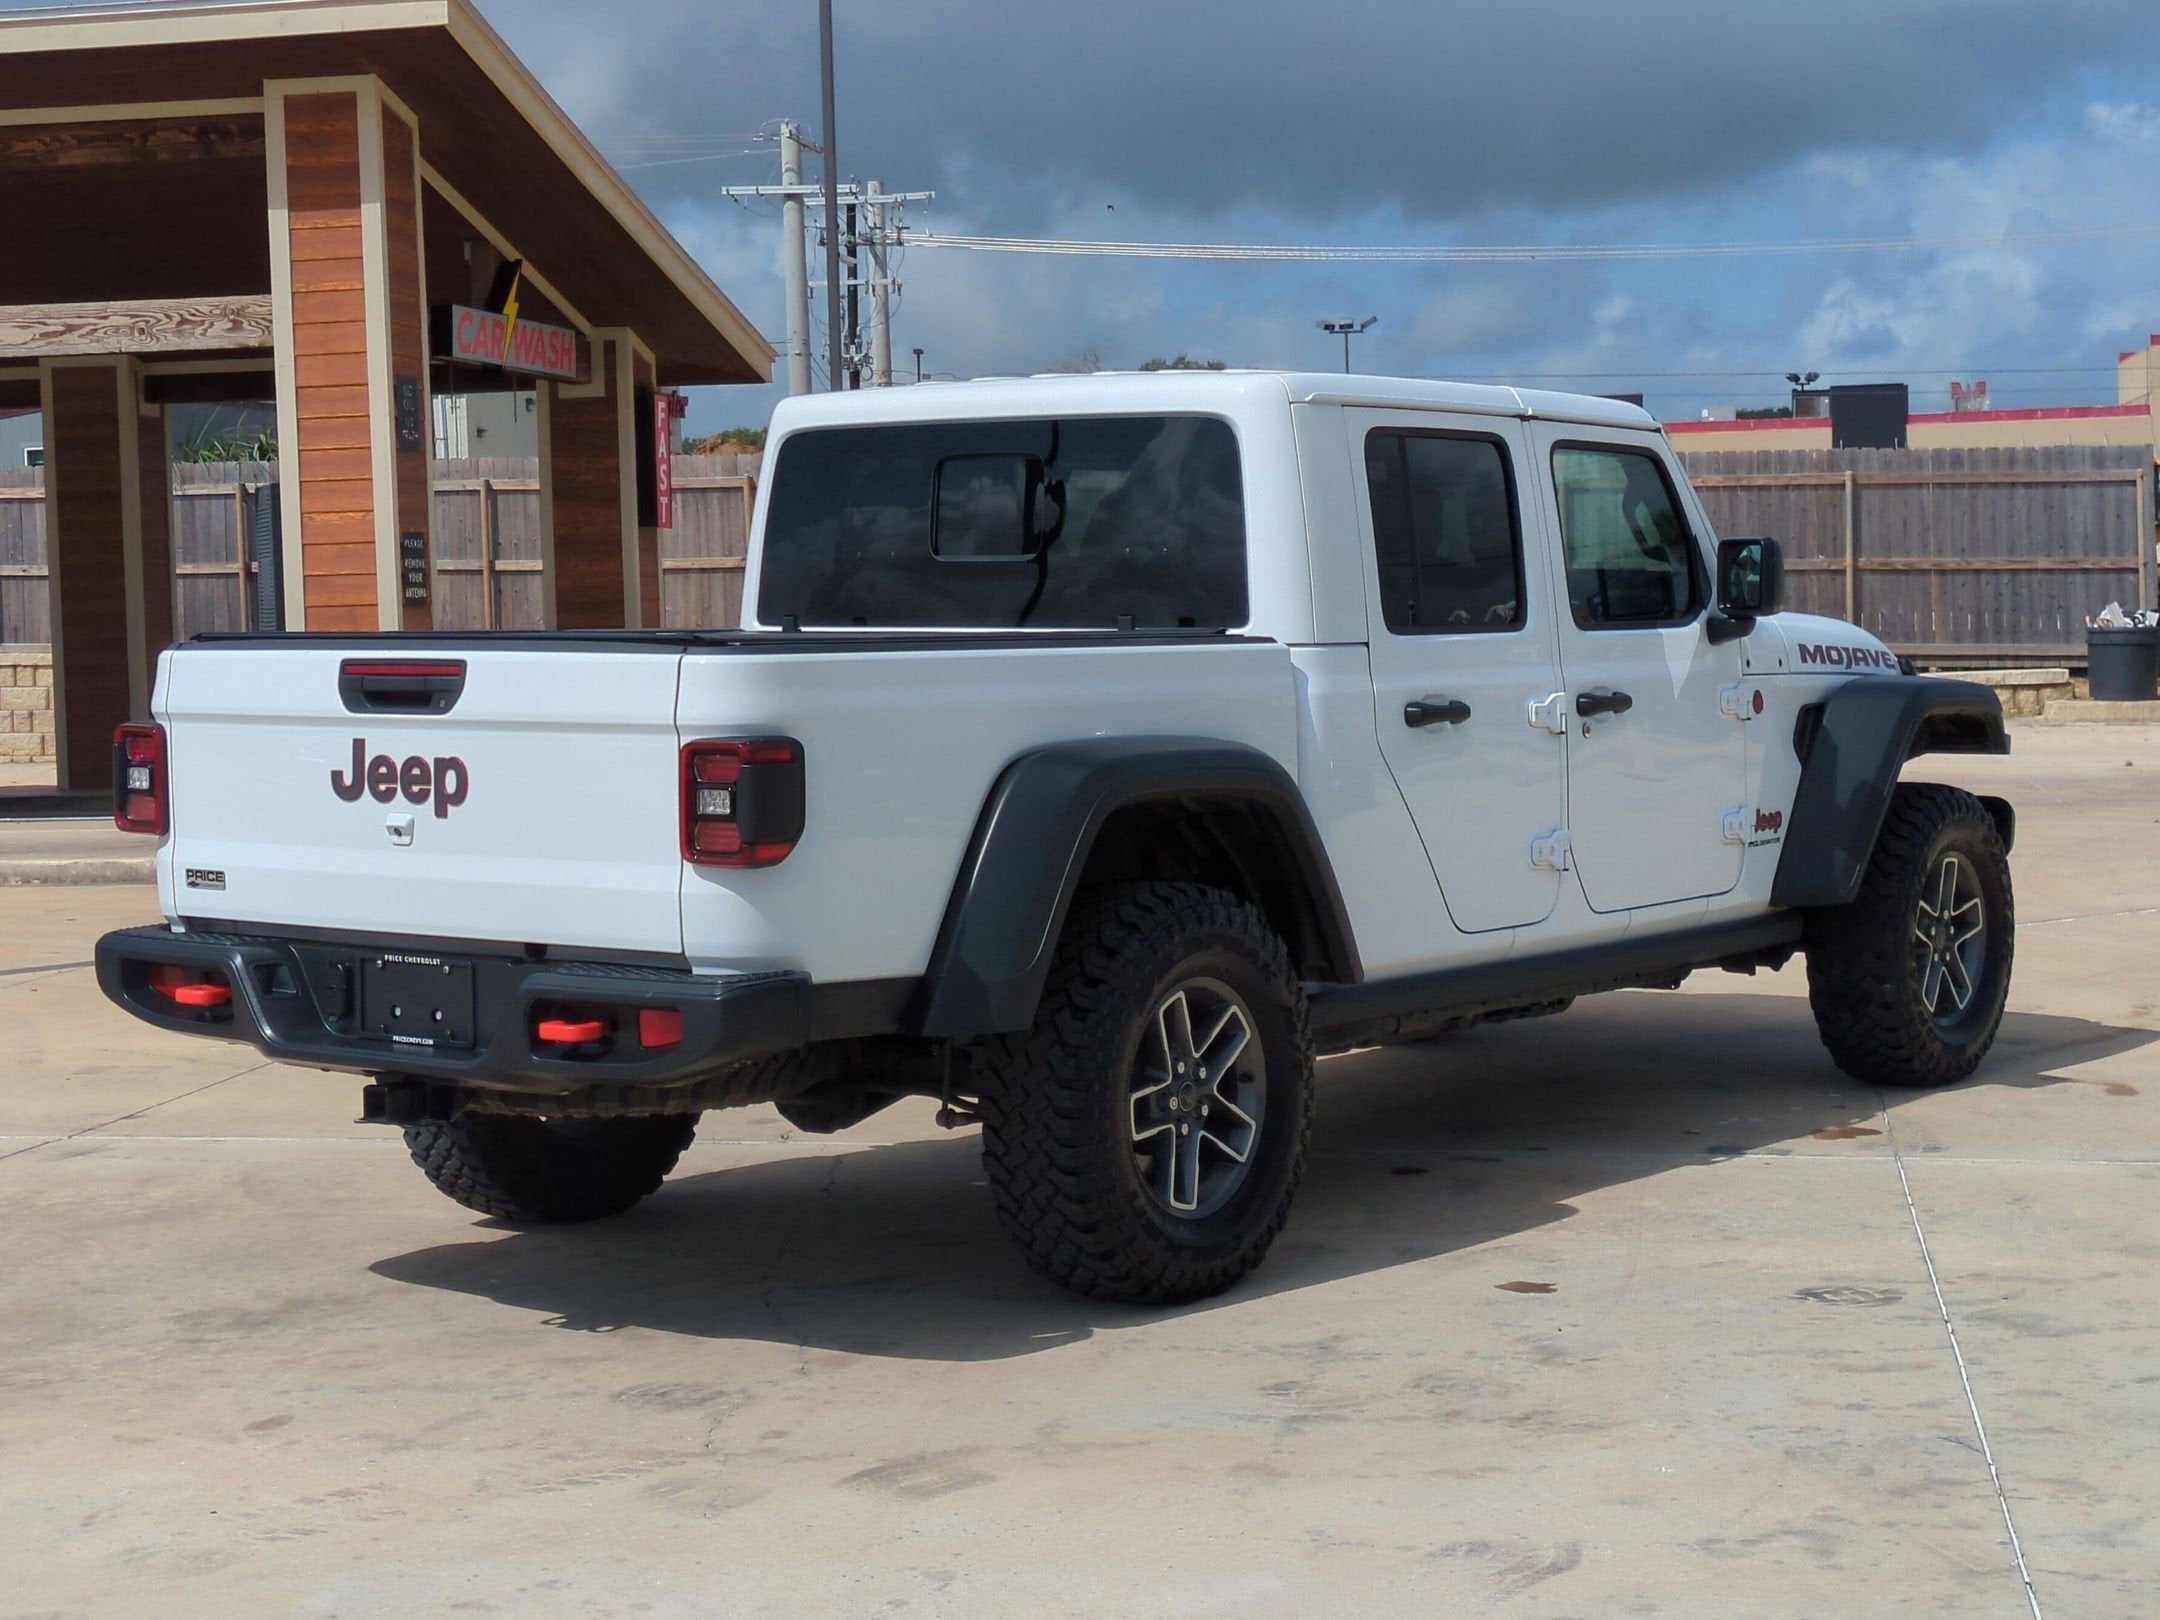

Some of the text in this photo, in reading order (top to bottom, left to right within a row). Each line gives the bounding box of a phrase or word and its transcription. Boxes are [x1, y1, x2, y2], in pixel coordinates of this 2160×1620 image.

[456, 310, 575, 372] CAR WASH
[657, 401, 669, 523] FAST
[1797, 644, 1897, 670] MOJAVE
[330, 737, 469, 819] Jeep
[1754, 808, 1782, 834] Jeep
[186, 869, 225, 882] PRICE
[384, 954, 441, 966] PRICE CHEVROLET
